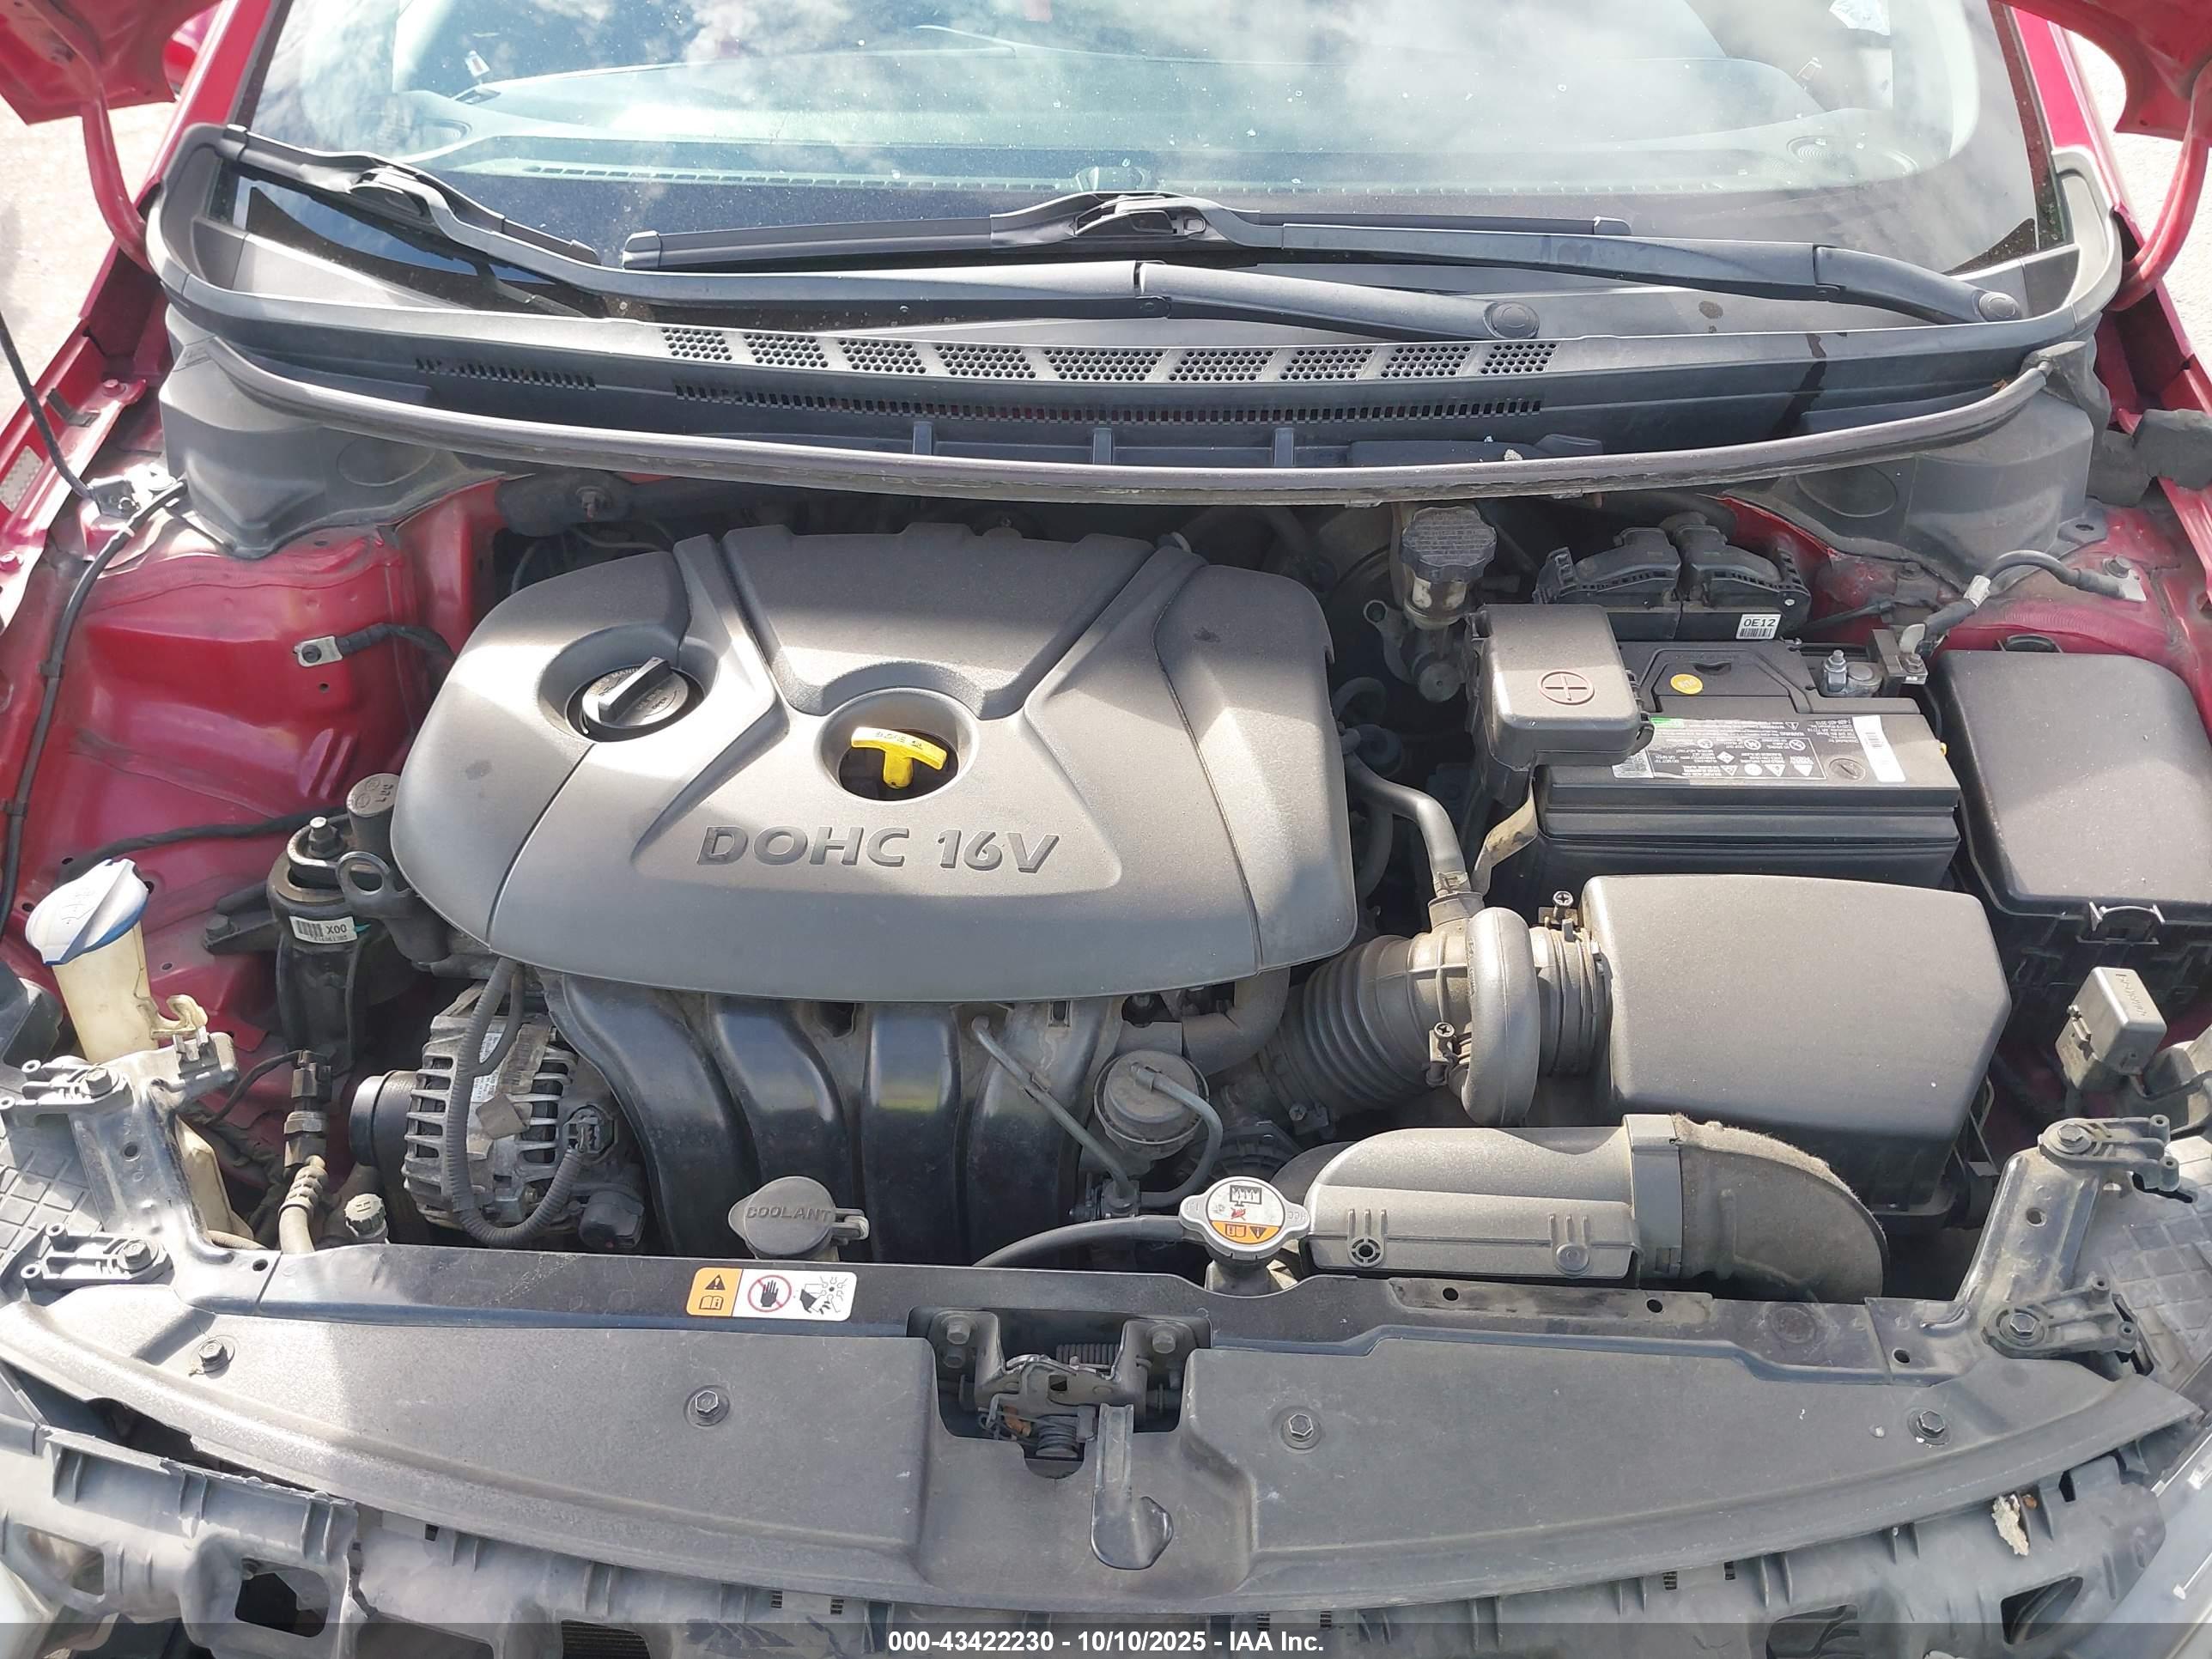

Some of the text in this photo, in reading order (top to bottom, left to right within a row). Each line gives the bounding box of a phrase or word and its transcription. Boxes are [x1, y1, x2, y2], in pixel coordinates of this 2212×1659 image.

[696, 825, 1060, 874] DOHC 16V
[745, 1206, 832, 1223] COOLANT
